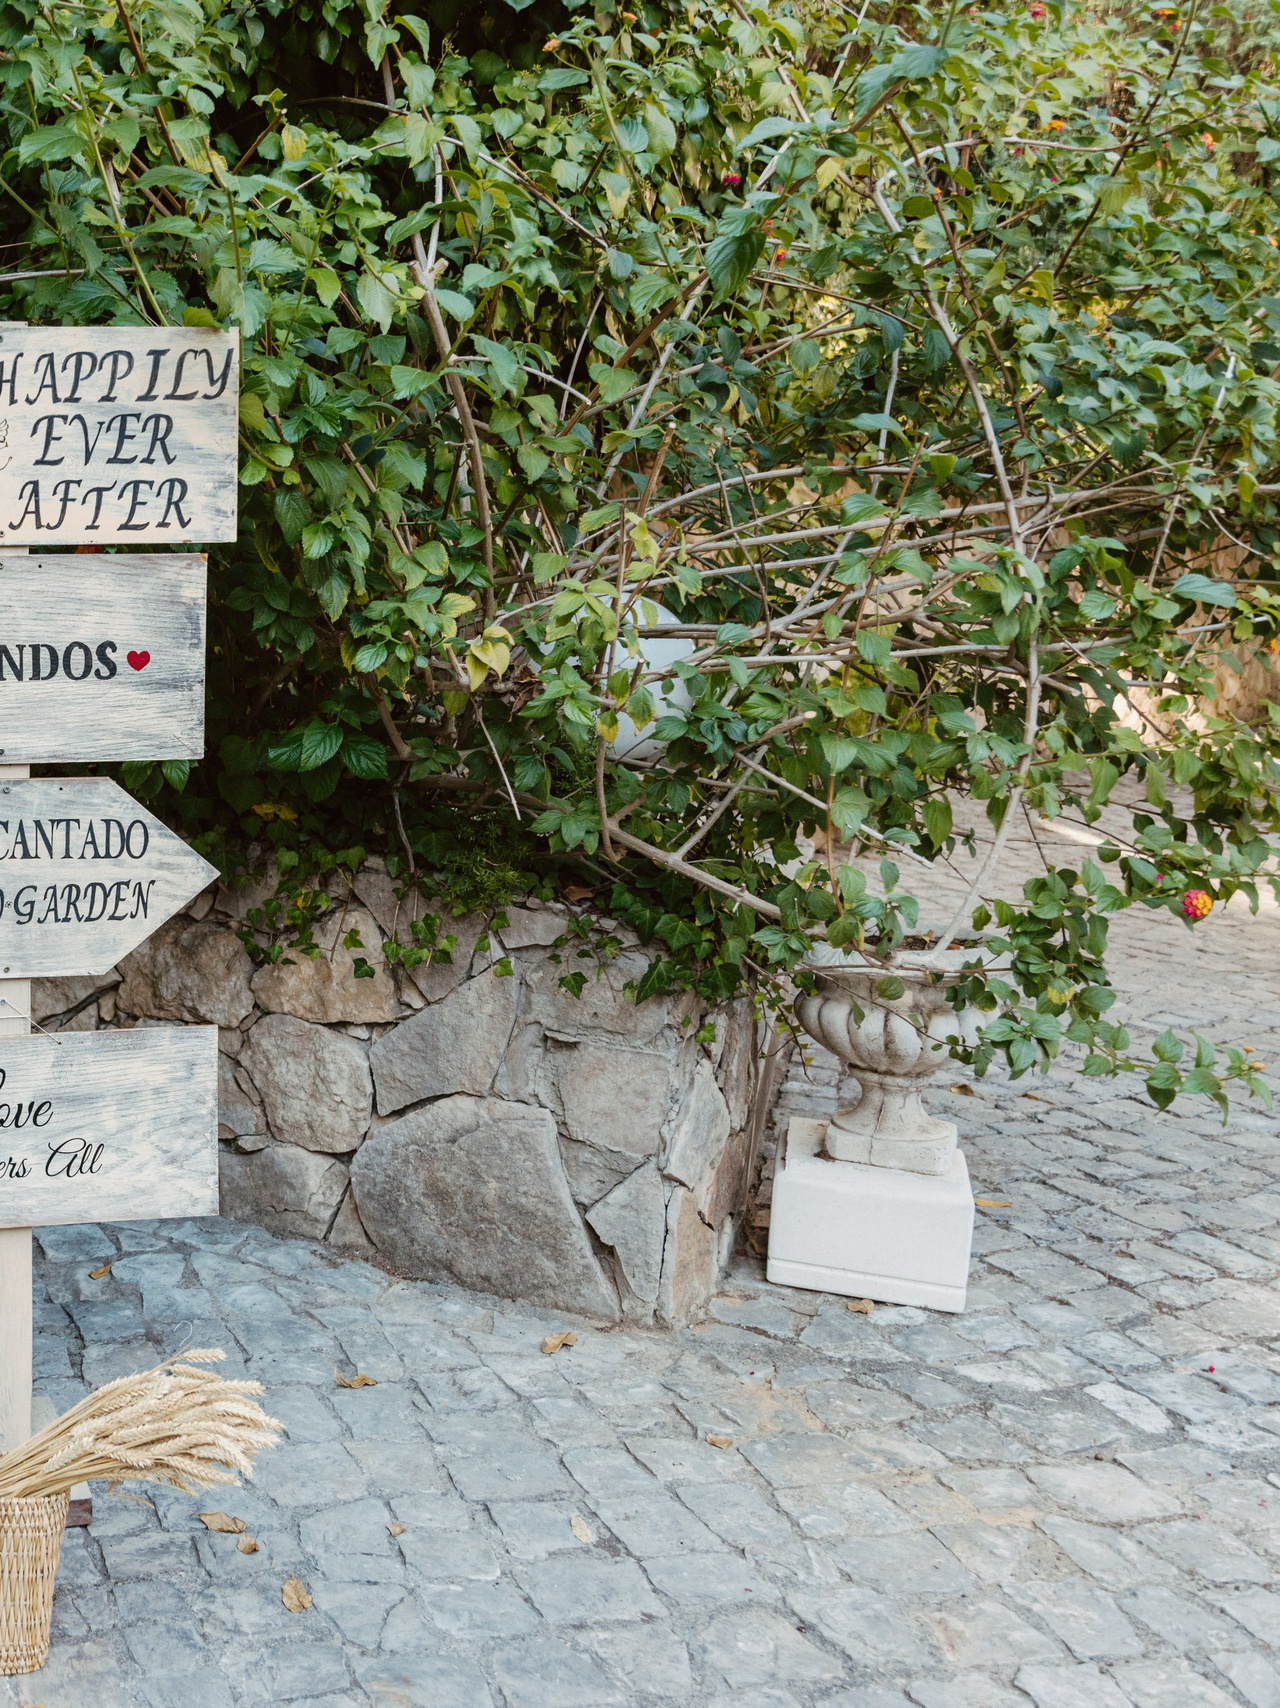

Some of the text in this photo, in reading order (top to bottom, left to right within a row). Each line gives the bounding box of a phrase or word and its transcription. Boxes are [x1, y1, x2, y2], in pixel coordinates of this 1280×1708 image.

[30, 413, 178, 467] EVER
[8, 478, 193, 532] AFTER
[13, 879, 156, 925] GARDEN
[46, 1137, 104, 1178] All
